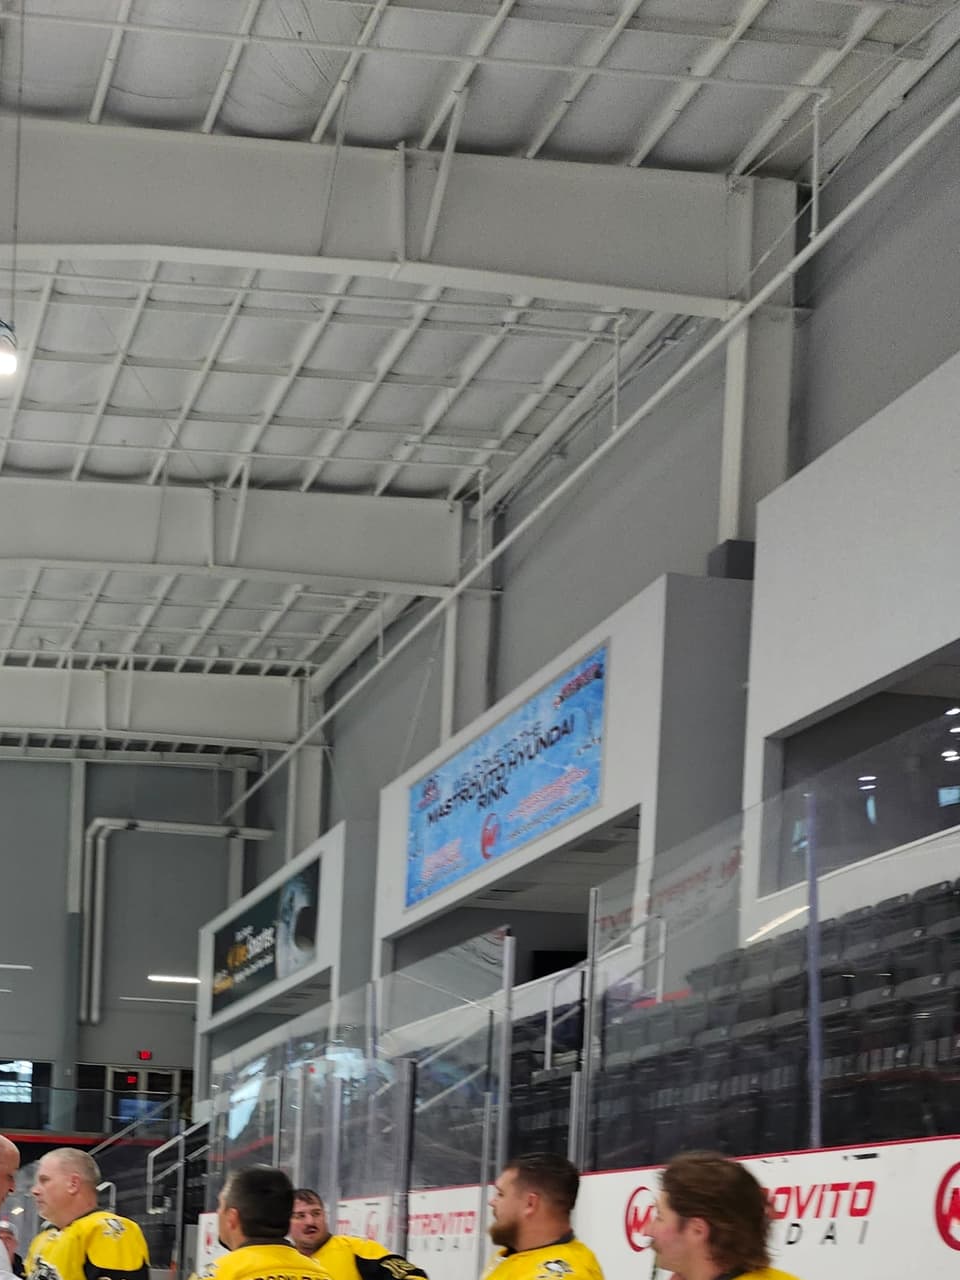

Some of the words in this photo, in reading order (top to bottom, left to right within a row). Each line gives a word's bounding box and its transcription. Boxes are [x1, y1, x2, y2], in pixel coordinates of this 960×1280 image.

[427, 762, 506, 825] MASTROVITO
[508, 714, 575, 774] HYUNDAI
[476, 781, 509, 812] RINK
